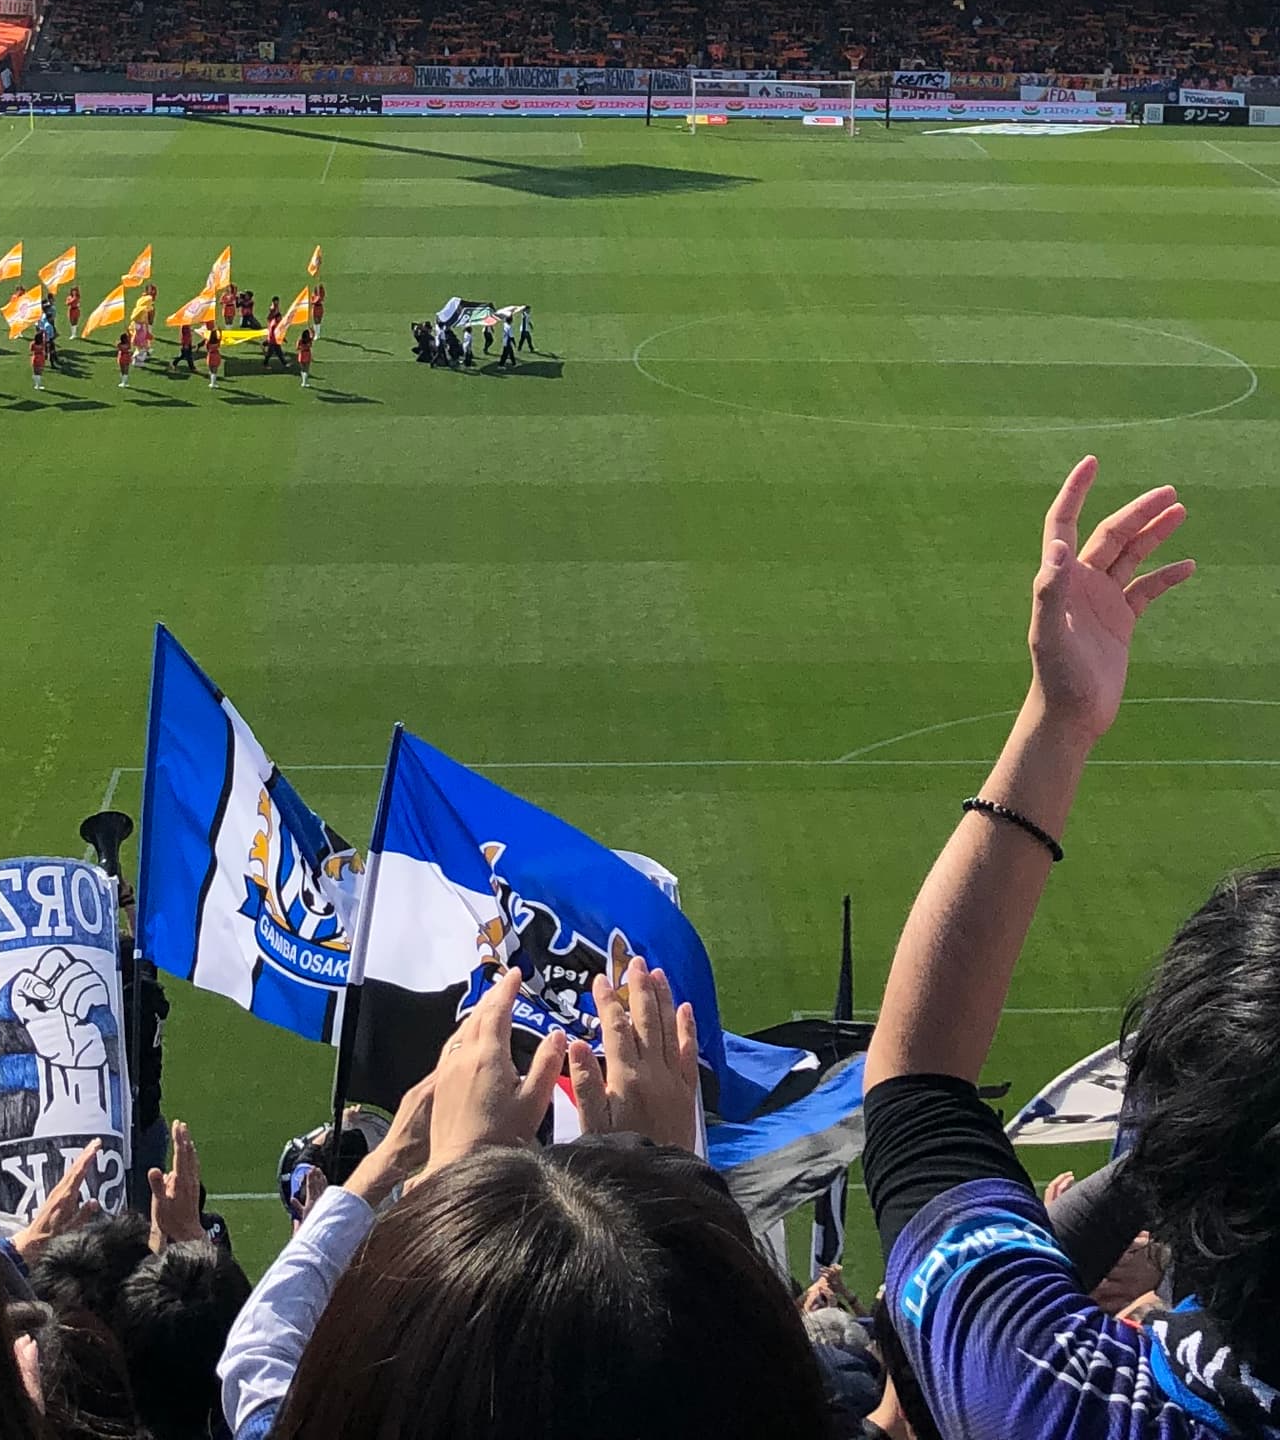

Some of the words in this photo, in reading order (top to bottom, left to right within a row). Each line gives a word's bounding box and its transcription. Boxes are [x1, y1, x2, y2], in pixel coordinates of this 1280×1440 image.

[416, 67, 451, 87] HWANG
[1049, 88, 1077, 102] FDA
[259, 914, 298, 965] GAMBA
[299, 949, 351, 979] OSAK
[542, 964, 589, 985] 1991
